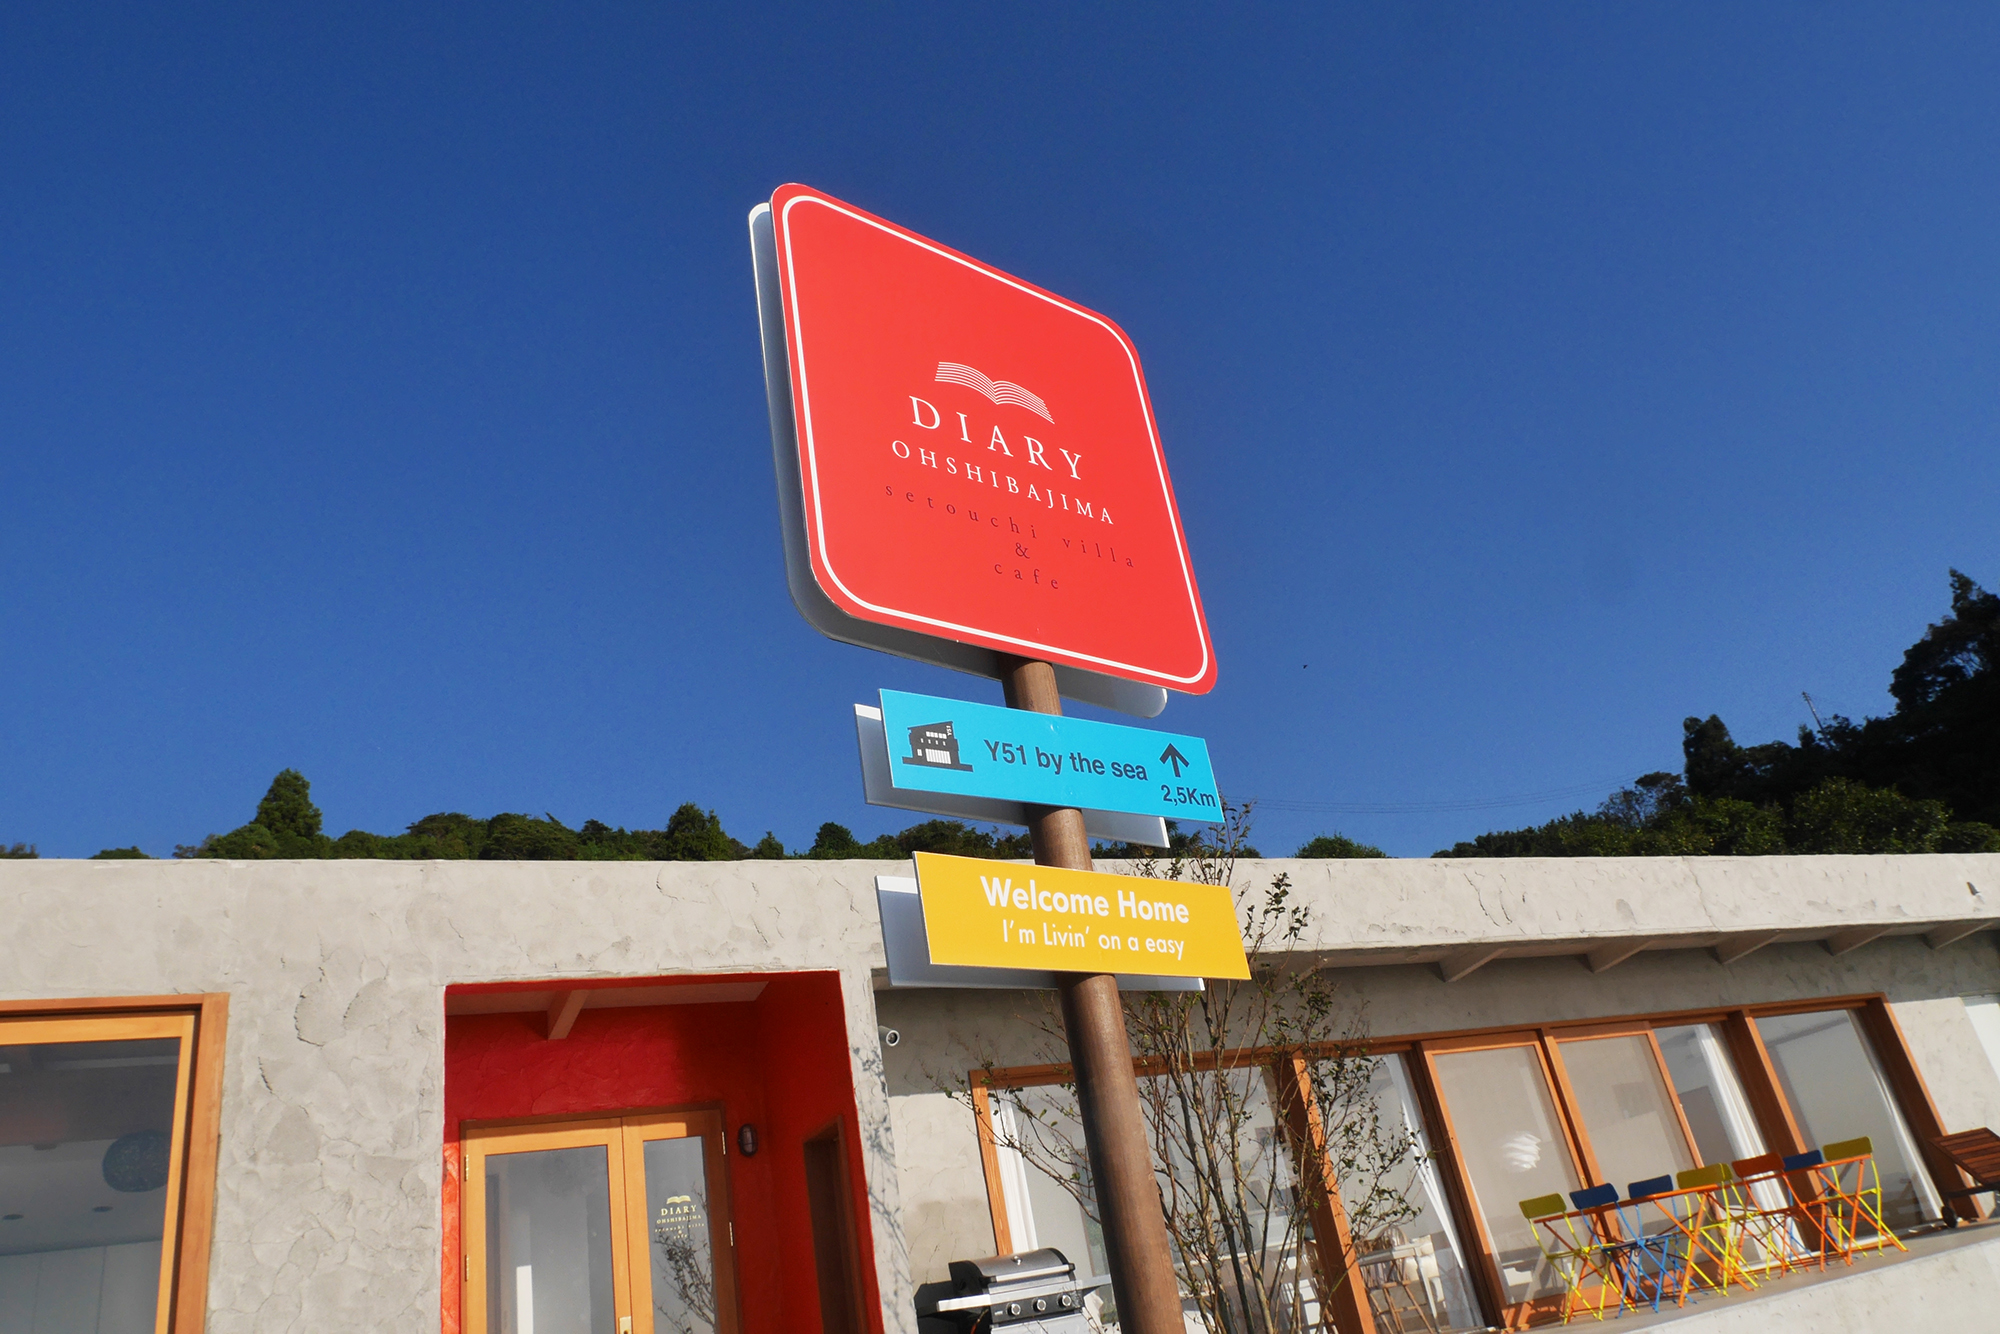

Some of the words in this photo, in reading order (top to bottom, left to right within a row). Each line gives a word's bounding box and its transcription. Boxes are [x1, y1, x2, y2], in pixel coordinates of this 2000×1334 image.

[909, 395, 1082, 480] DIARY
[891, 440, 1114, 525] OHSHIBAJIMA
[885, 485, 1037, 539] setouchi
[1062, 537, 1134, 568] villa
[1015, 542, 1031, 559] &
[994, 562, 1059, 589] cafe
[983, 739, 1027, 765] Y51
[1035, 746, 1063, 775] by
[1069, 752, 1105, 775] the
[1111, 760, 1148, 781] sea
[1160, 784, 1217, 807] 2,5Km
[980, 875, 1109, 917] Welcome
[1117, 889, 1189, 924] Home
[1002, 919, 1035, 944] I'm
[1043, 922, 1090, 948] Livin'
[1098, 934, 1121, 950] on
[1127, 937, 1139, 951] a
[1145, 938, 1184, 961] easy
[661, 1205, 696, 1216] DIARY
